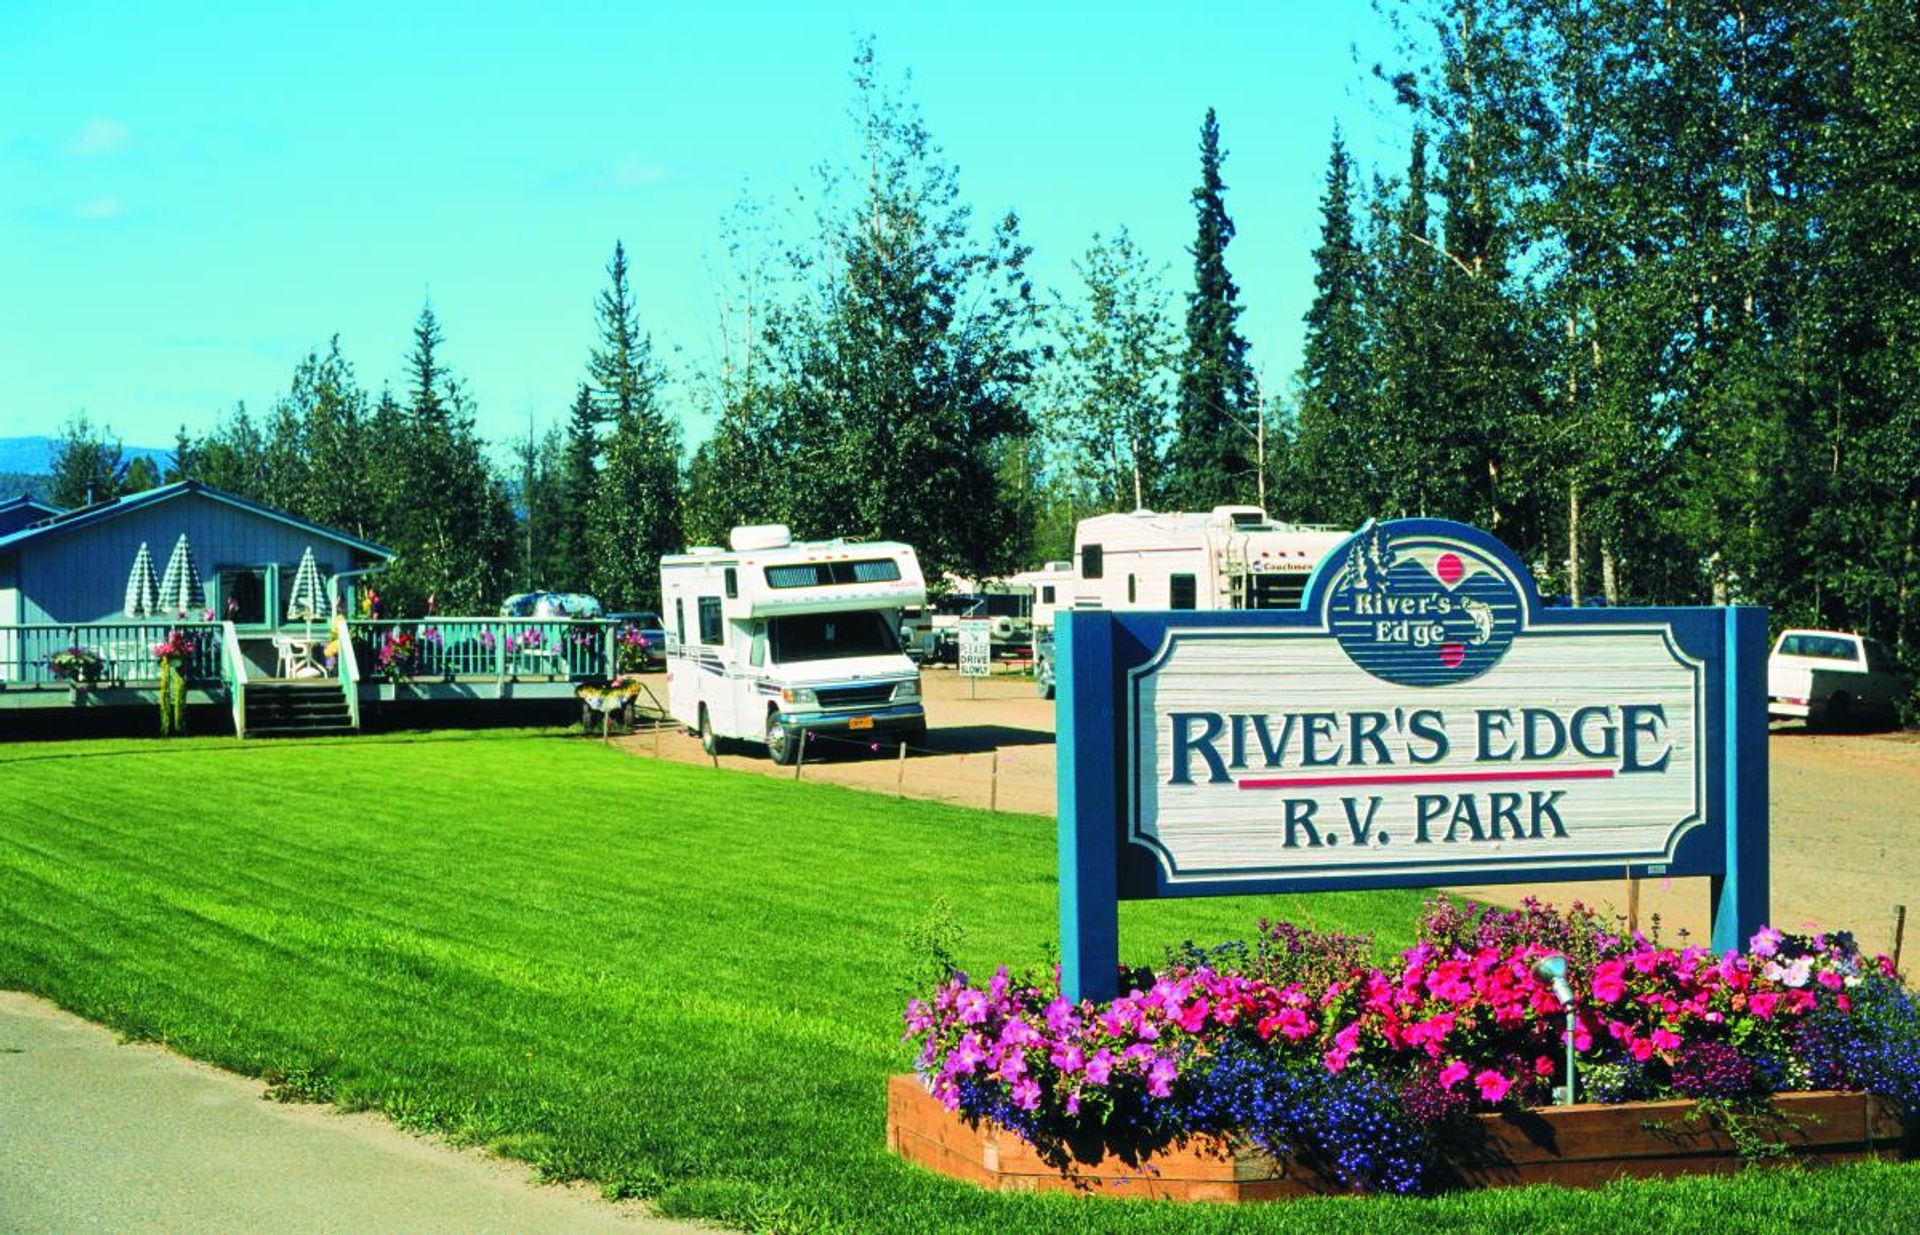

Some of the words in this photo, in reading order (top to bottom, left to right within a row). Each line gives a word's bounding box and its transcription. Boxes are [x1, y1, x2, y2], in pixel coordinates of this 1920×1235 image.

[1355, 593, 1450, 615] River's
[1376, 620, 1444, 647] Edge
[960, 655, 988, 664] DRIVE
[960, 665, 988, 674] SLOWLY
[1168, 708, 1449, 785] RIVER'S
[1475, 704, 1673, 773] EDGE
[1282, 796, 1390, 847] R.V.
[1414, 790, 1569, 843] PARK
